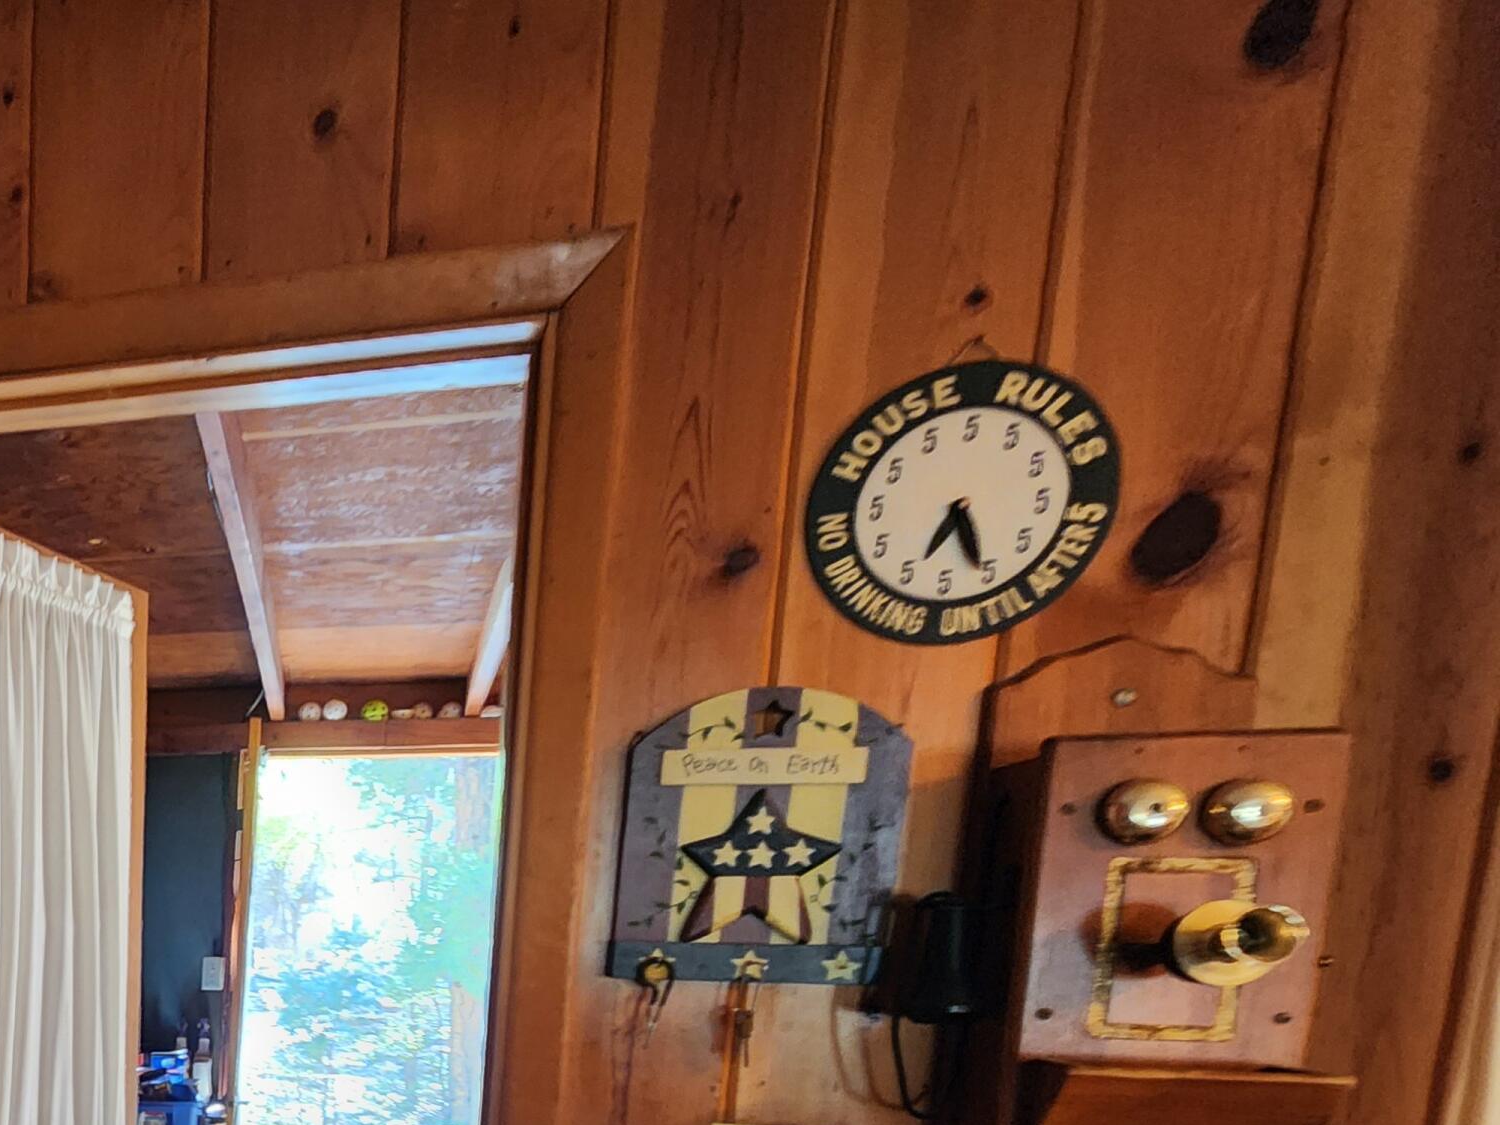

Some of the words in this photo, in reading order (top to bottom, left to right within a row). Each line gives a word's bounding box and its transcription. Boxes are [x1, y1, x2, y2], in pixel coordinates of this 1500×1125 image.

[831, 375, 962, 482] HOUSE
[993, 370, 1108, 466] RULES
[962, 415, 980, 442] 5
[1003, 422, 1021, 450] 5
[921, 427, 940, 455] 5
[885, 457, 904, 485] 5
[1028, 451, 1046, 478] 5
[868, 495, 885, 522] 5
[1033, 487, 1051, 514] 5
[817, 512, 849, 553] NO
[872, 533, 891, 559] 5
[1015, 527, 1034, 554] 5
[899, 560, 916, 585] 5
[936, 569, 953, 595] 5
[980, 559, 997, 585] 5
[824, 555, 928, 636] DRINKING
[940, 587, 1035, 636] UNTIL
[681, 753, 737, 777] Peace
[786, 753, 841, 776] Earth
